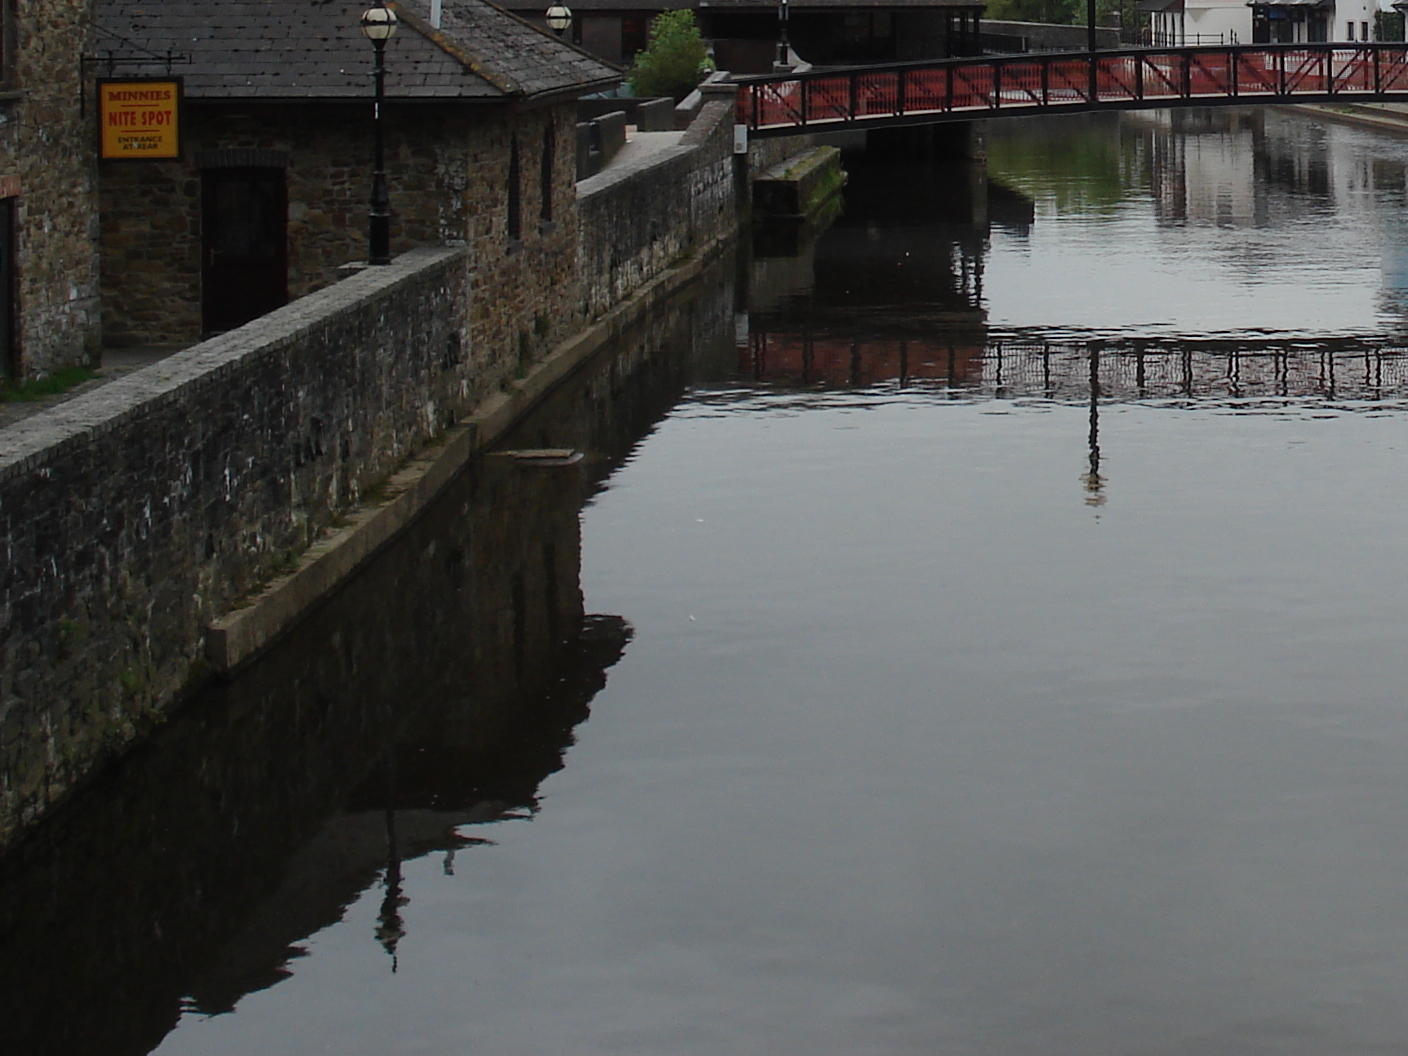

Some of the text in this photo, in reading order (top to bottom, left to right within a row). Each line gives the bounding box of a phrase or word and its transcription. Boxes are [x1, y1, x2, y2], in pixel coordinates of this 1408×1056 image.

[108, 90, 171, 101] MINNIES
[109, 110, 172, 126] NITE SPOT
[118, 135, 162, 143] ENTRANCE
[137, 142, 158, 150] REAR
